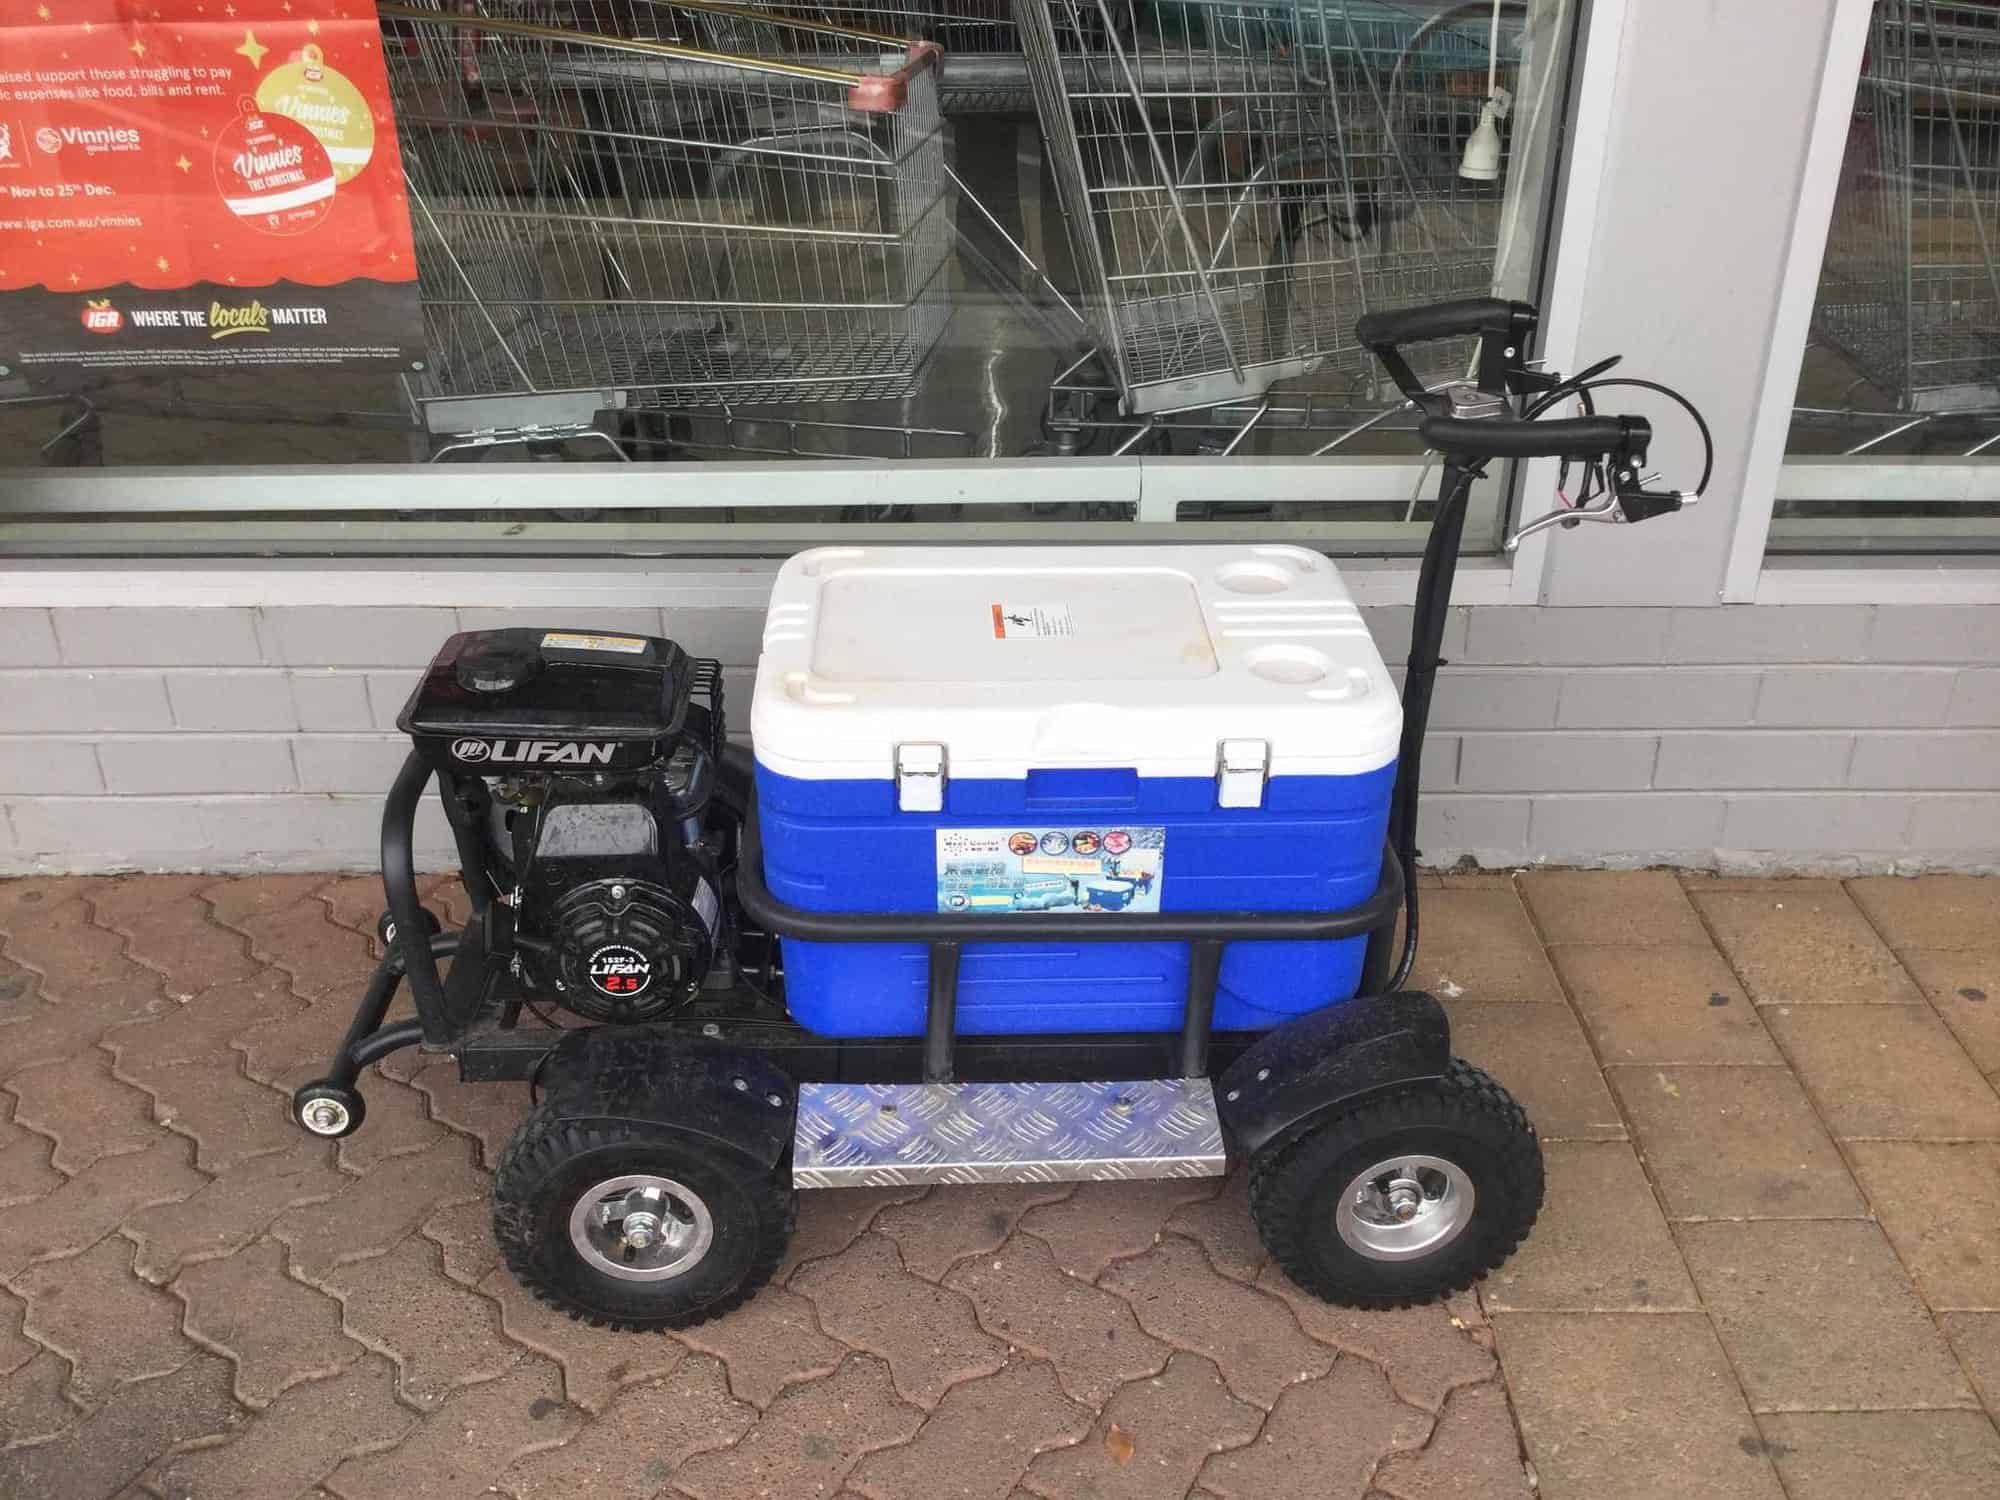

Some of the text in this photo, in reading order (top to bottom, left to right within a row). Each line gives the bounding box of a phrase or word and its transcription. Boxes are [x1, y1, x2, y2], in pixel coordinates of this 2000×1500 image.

[0, 66, 232, 85] aised support those struggling to pay
[15, 87, 75, 102] expenses
[79, 85, 99, 98] like
[103, 83, 136, 99] food,
[140, 83, 165, 97] bills
[168, 83, 192, 96] and
[195, 83, 225, 97] rent.
[60, 126, 140, 144] Vinnies
[232, 143, 304, 178] Vinnies
[10, 185, 38, 199] Nov
[39, 185, 56, 198] to
[0, 214, 143, 232] ww.iga.com.au/vinnies
[87, 310, 120, 329] IGA
[130, 300, 328, 328] WHERE THE locals MATTER
[490, 740, 617, 764] LIFAN
[590, 963, 650, 975] LIFAN
[606, 975, 638, 991] 2.5
